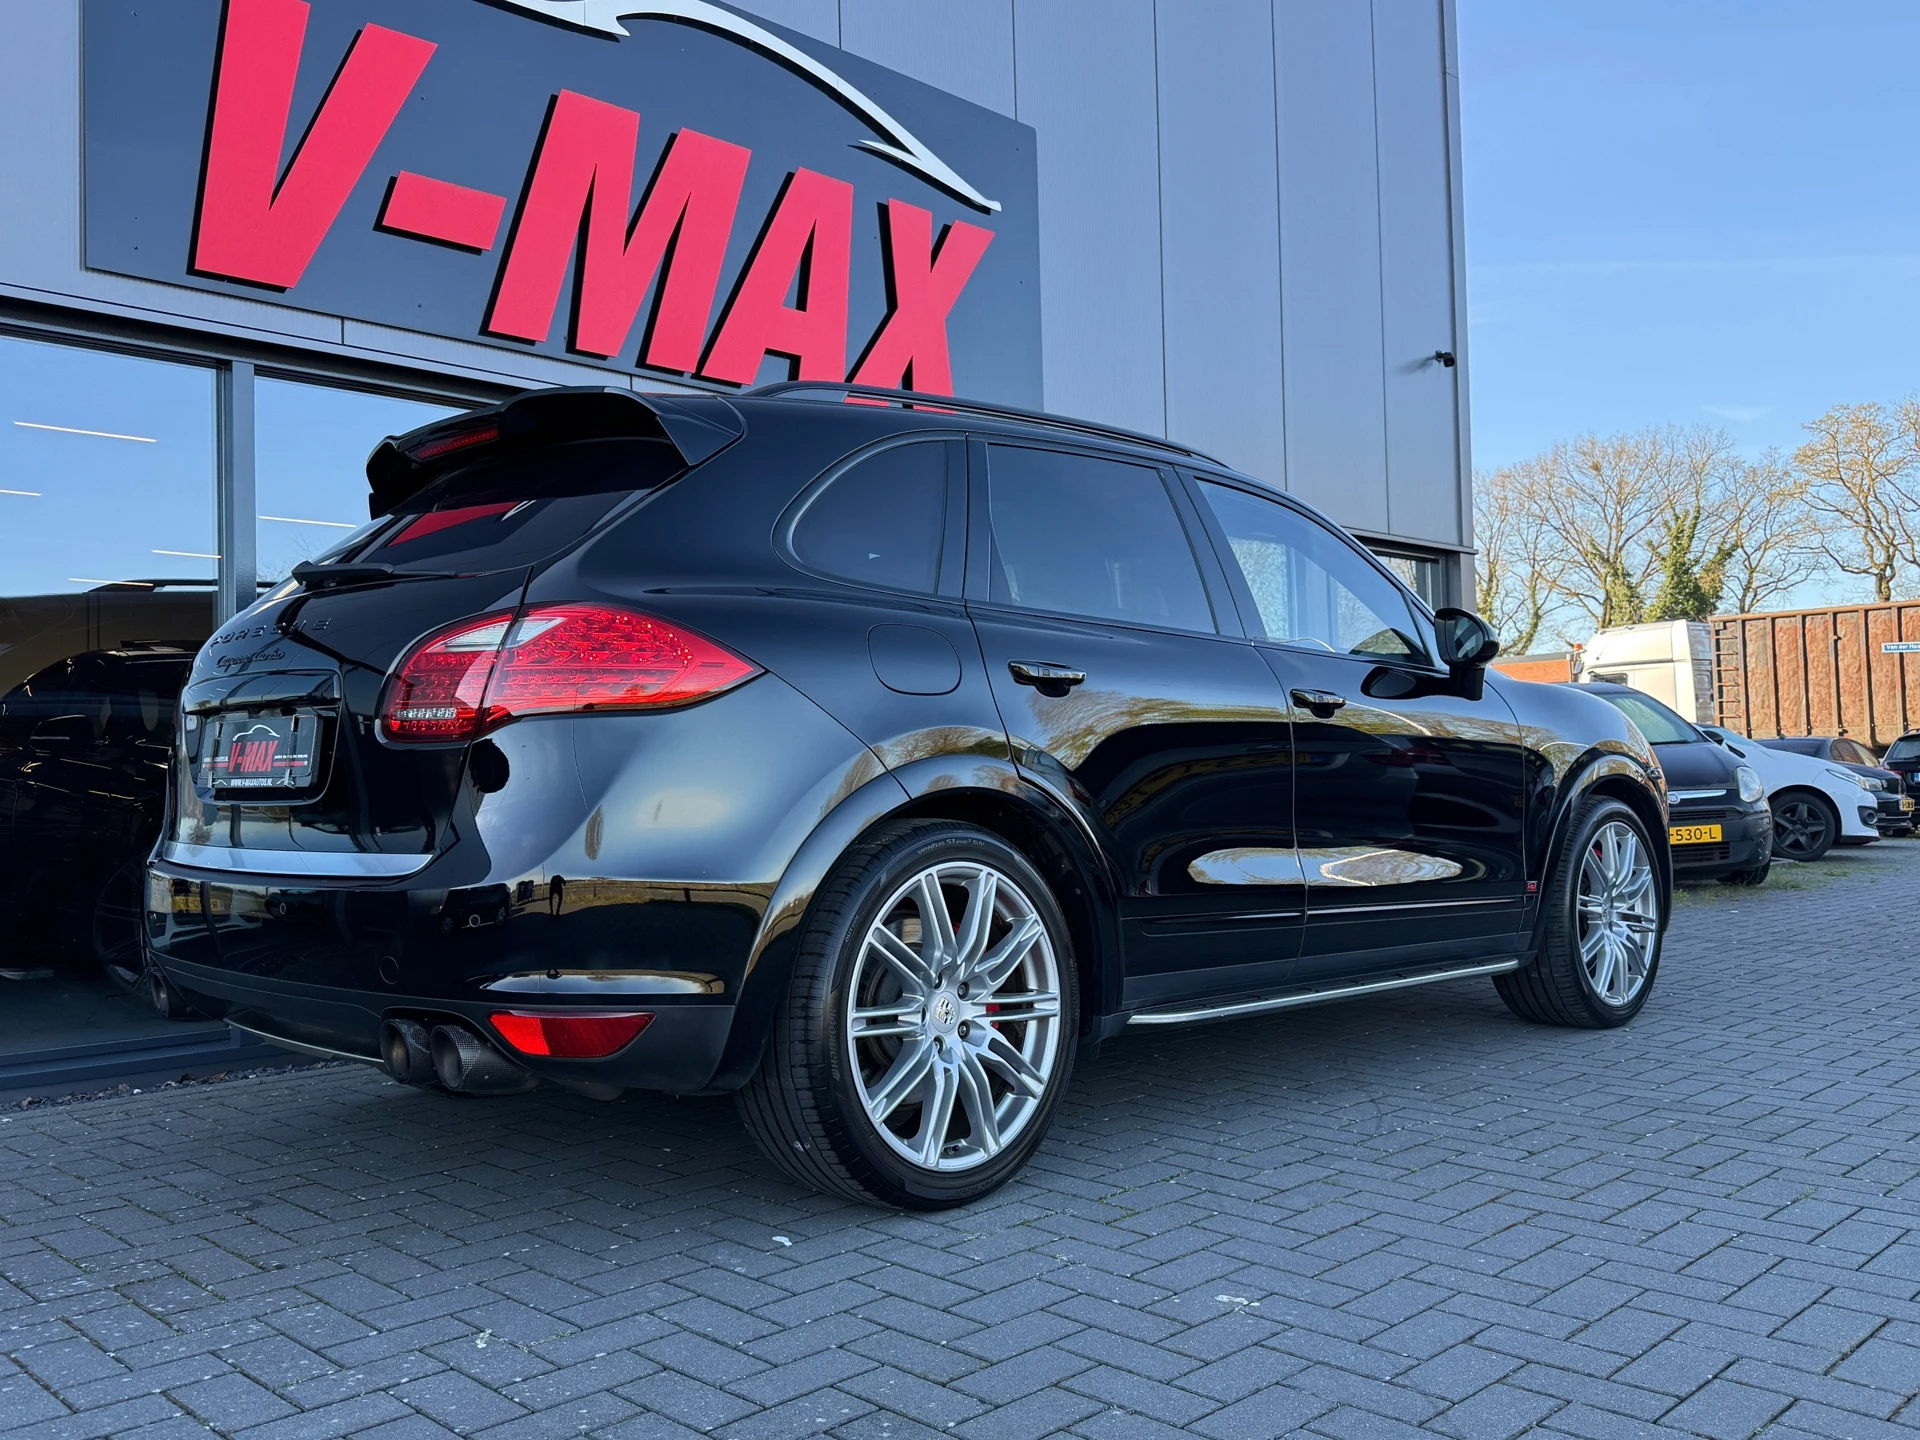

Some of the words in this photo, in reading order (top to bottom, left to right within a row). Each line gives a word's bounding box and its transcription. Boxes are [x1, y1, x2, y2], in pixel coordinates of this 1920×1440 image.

[194, 0, 996, 412] V-MAX
[229, 740, 278, 773] V-MAX
[1669, 827, 1717, 841] -530-L
